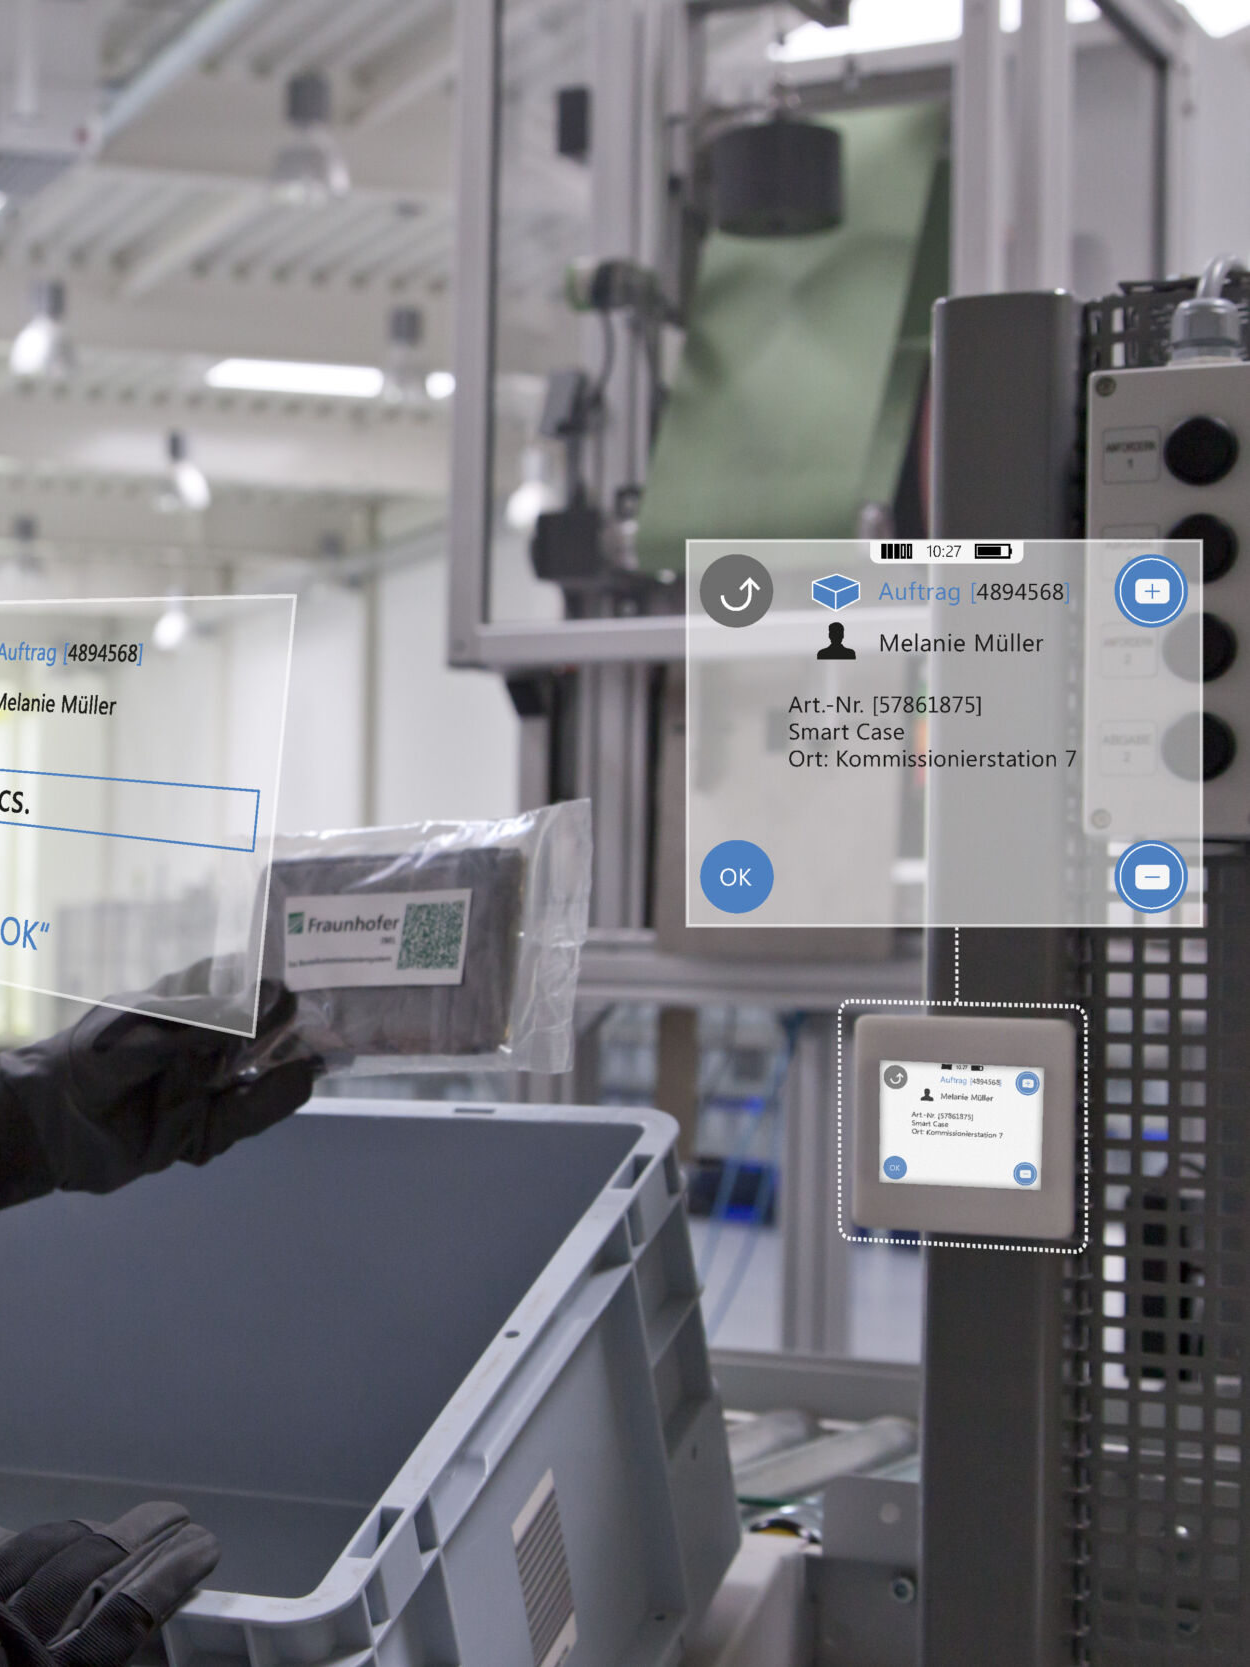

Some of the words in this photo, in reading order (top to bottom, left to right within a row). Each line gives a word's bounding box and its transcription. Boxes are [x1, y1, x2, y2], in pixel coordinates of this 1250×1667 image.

[308, 914, 400, 933] Fraunhofer
[940, 1076, 968, 1086] Auftrag
[940, 1093, 969, 1101] Melanie
[970, 1094, 994, 1102] Müller
[932, 1120, 949, 1128] Case
[926, 1130, 997, 1139] Kommissionierstation
[889, 1164, 900, 1172] OK
